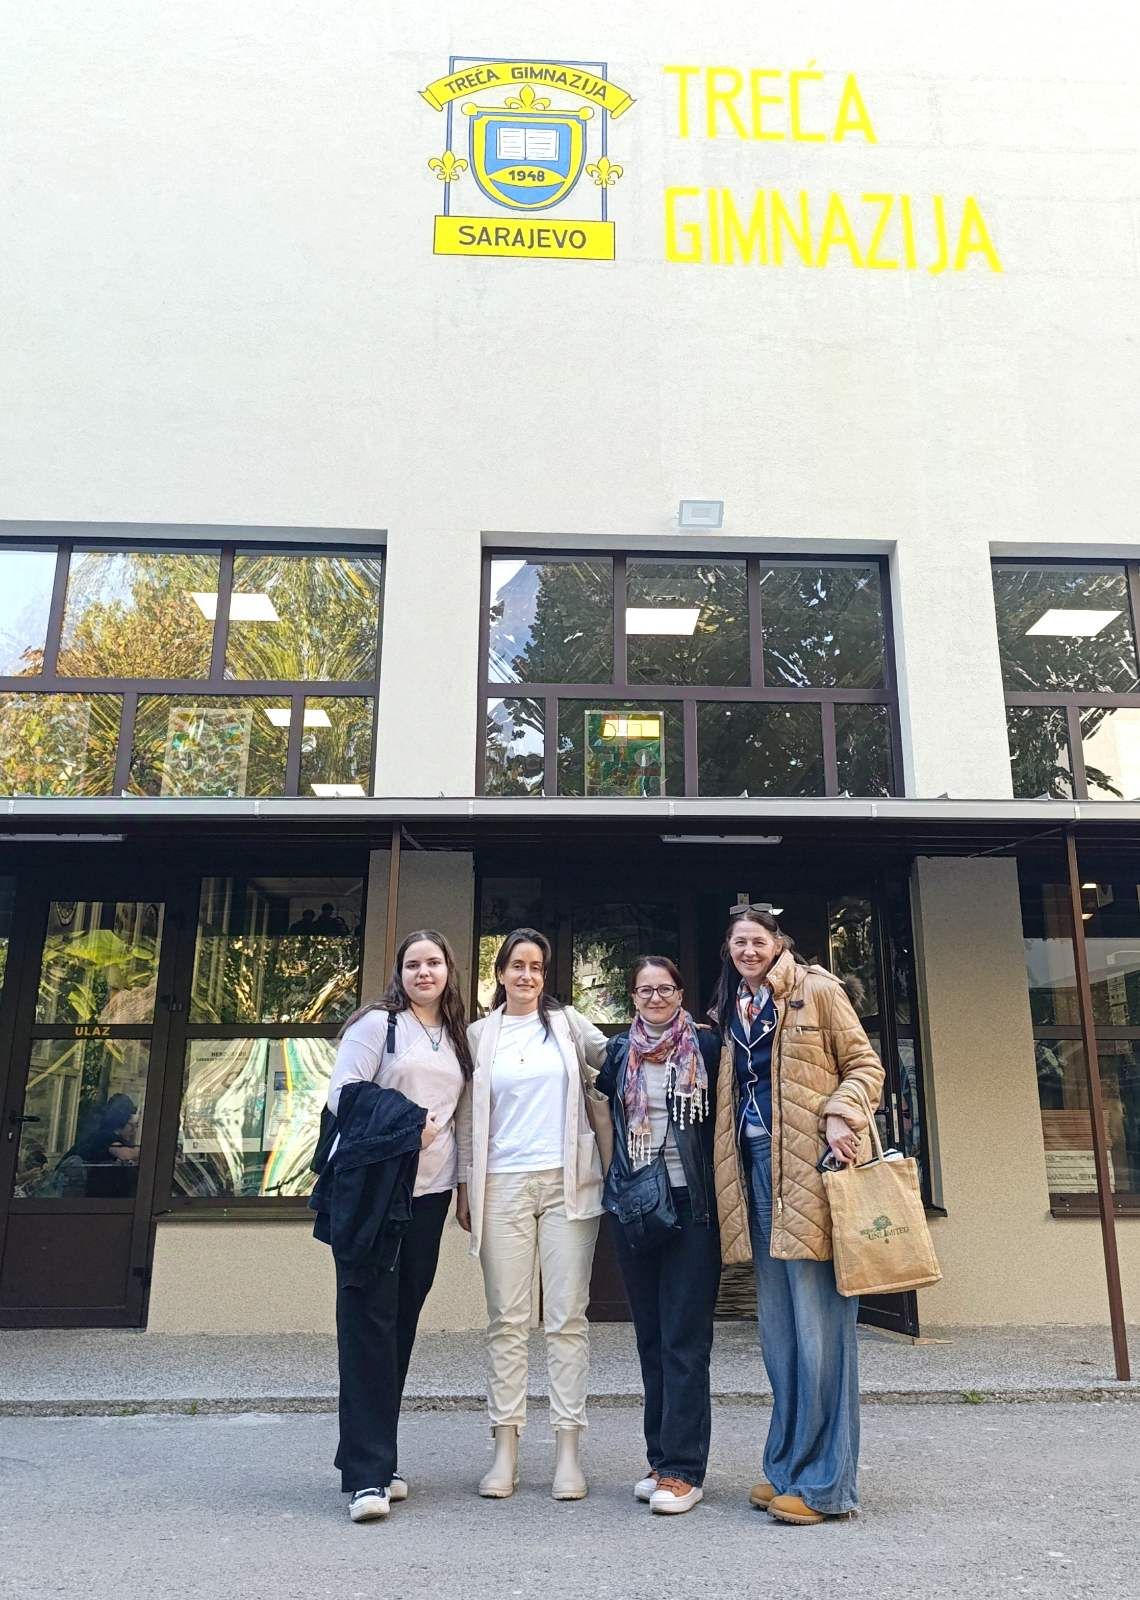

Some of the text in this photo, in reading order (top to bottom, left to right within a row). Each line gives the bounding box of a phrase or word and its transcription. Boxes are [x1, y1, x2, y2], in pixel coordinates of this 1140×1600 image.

[444, 66, 607, 101] TREĆA GIMNAZIJA
[663, 60, 877, 144] TREĆA
[508, 170, 545, 182] 1948
[458, 225, 587, 249] SARAJEVO
[663, 187, 1003, 274] GIMNAZIJA
[75, 1026, 110, 1036] ULAZ
